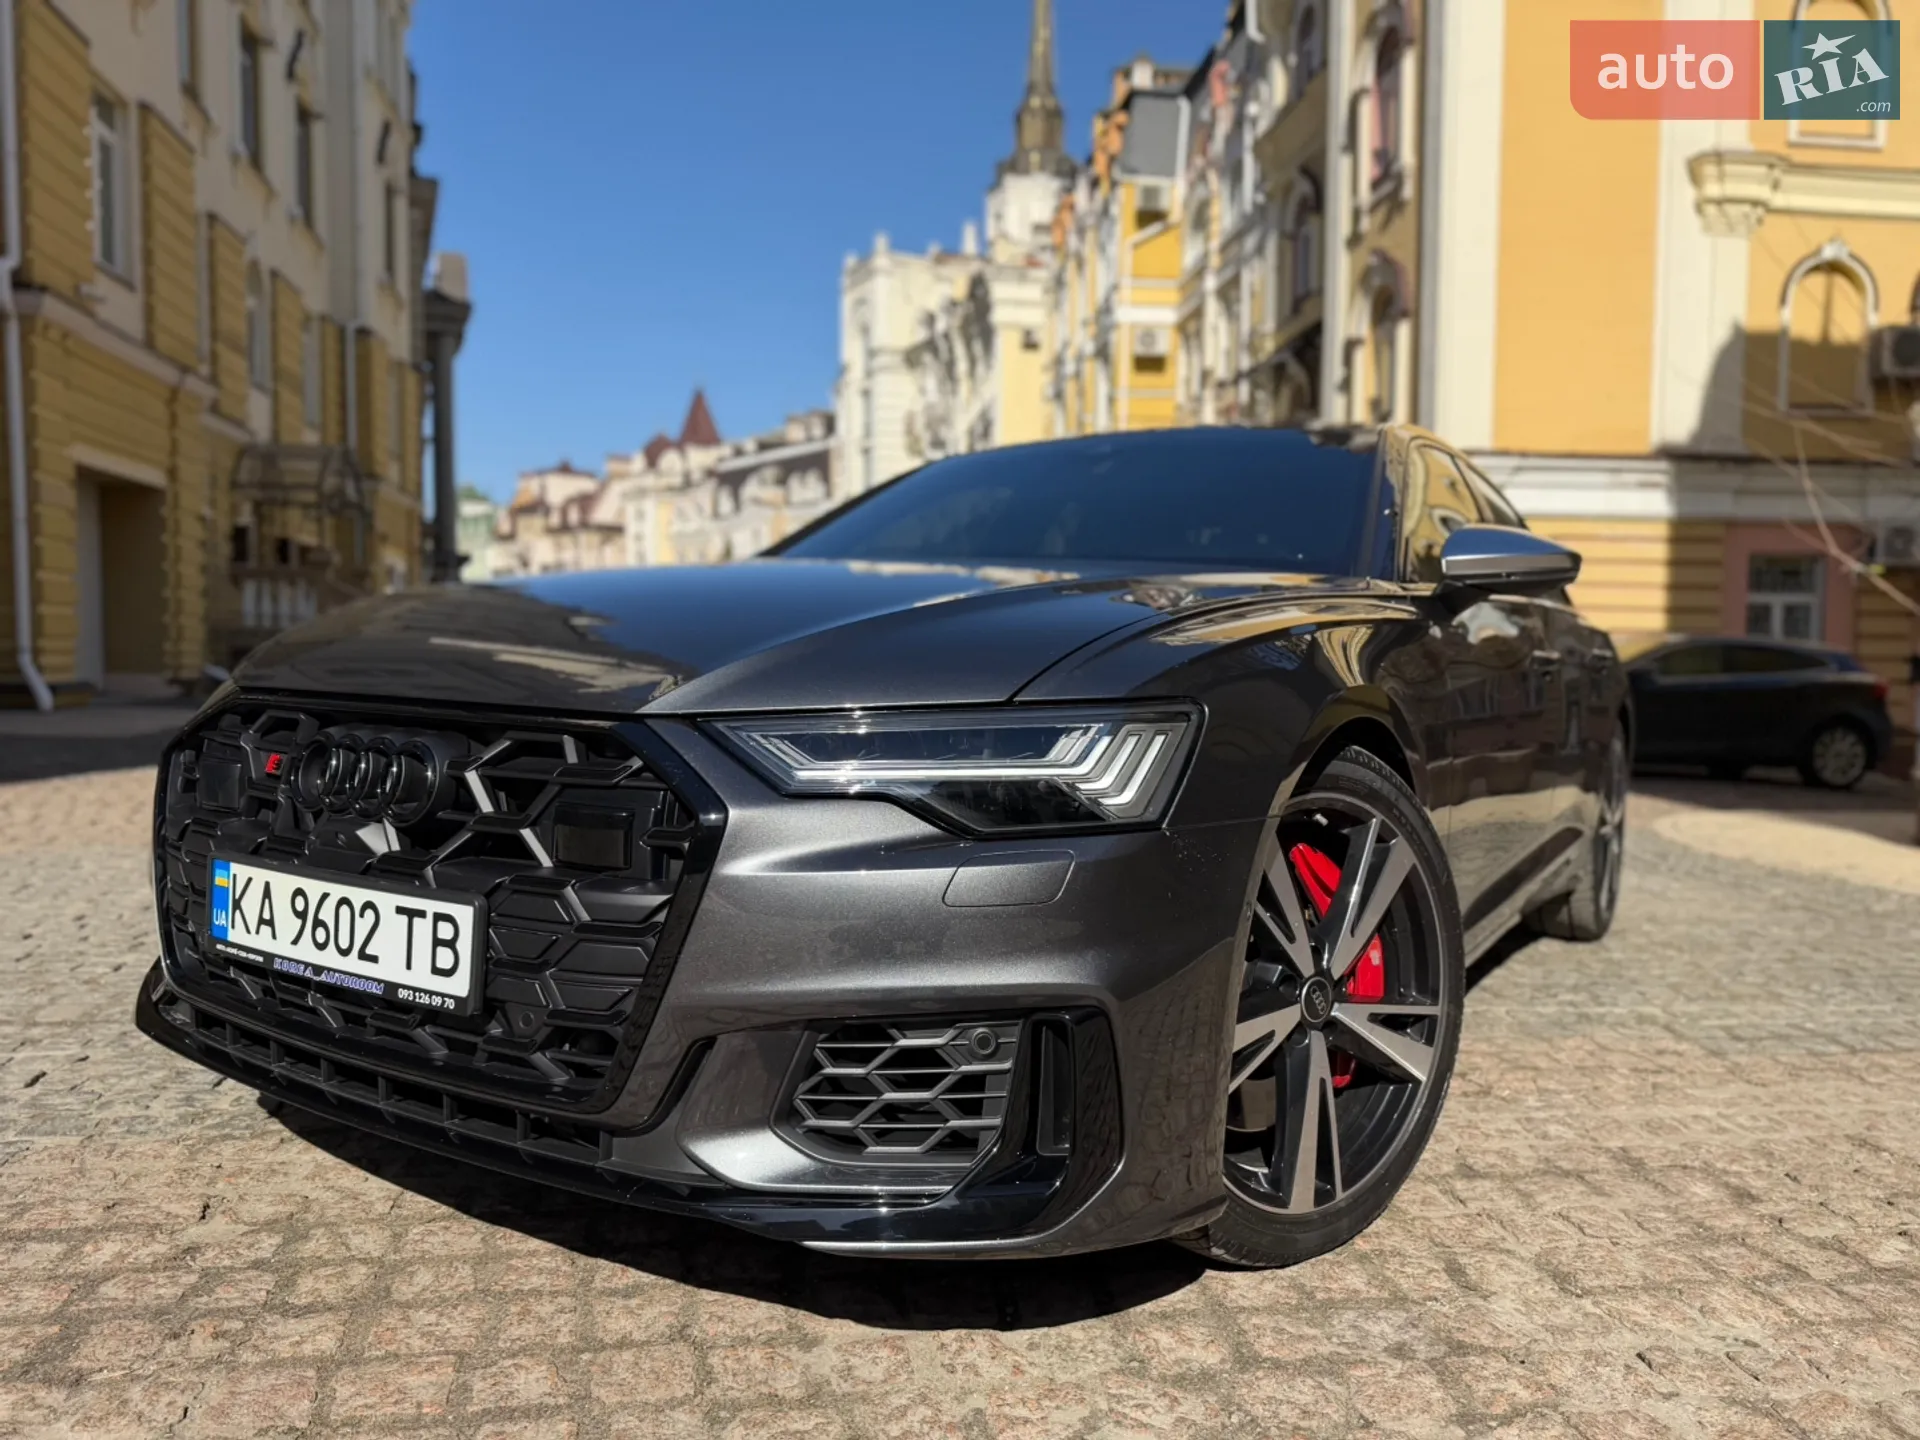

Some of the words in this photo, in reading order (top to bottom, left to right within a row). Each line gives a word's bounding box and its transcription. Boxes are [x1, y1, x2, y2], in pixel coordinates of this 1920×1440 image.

[213, 907, 227, 928] UA
[231, 873, 277, 940] KA
[290, 887, 381, 964] 9602
[395, 905, 460, 978] TB
[397, 988, 414, 1001] 093
[415, 991, 431, 1004] 126
[431, 995, 443, 1007] 09
[443, 997, 455, 1010] 70
